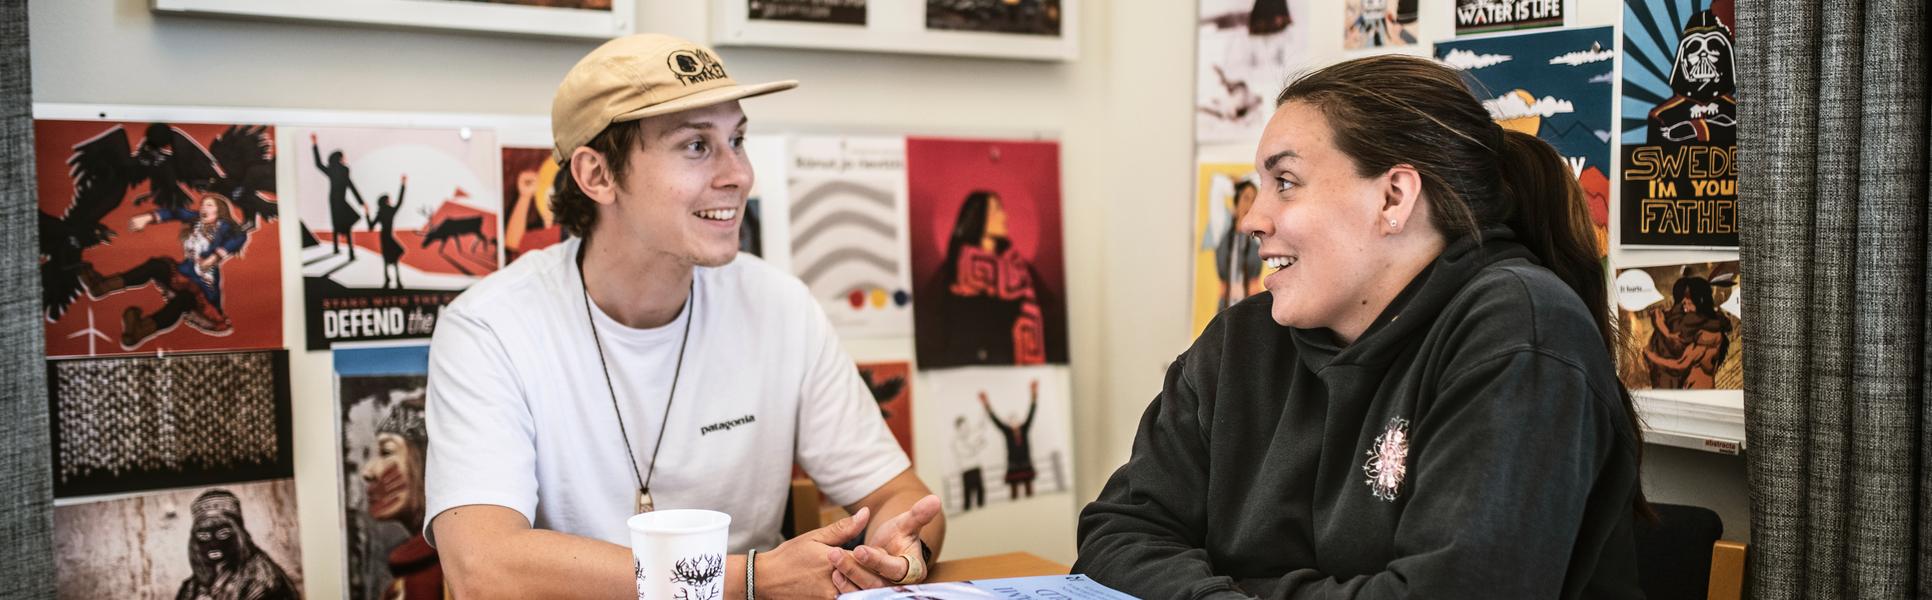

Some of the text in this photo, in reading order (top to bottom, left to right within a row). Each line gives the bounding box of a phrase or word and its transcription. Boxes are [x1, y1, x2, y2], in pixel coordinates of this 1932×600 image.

[1457, 0, 1561, 25] WATER IS LIFE
[1649, 177, 1739, 198] I'M YOU
[1641, 199, 1740, 234] FATHE
[323, 306, 405, 338] DEFEND
[407, 305, 434, 335] the
[701, 414, 756, 436] patagonia
